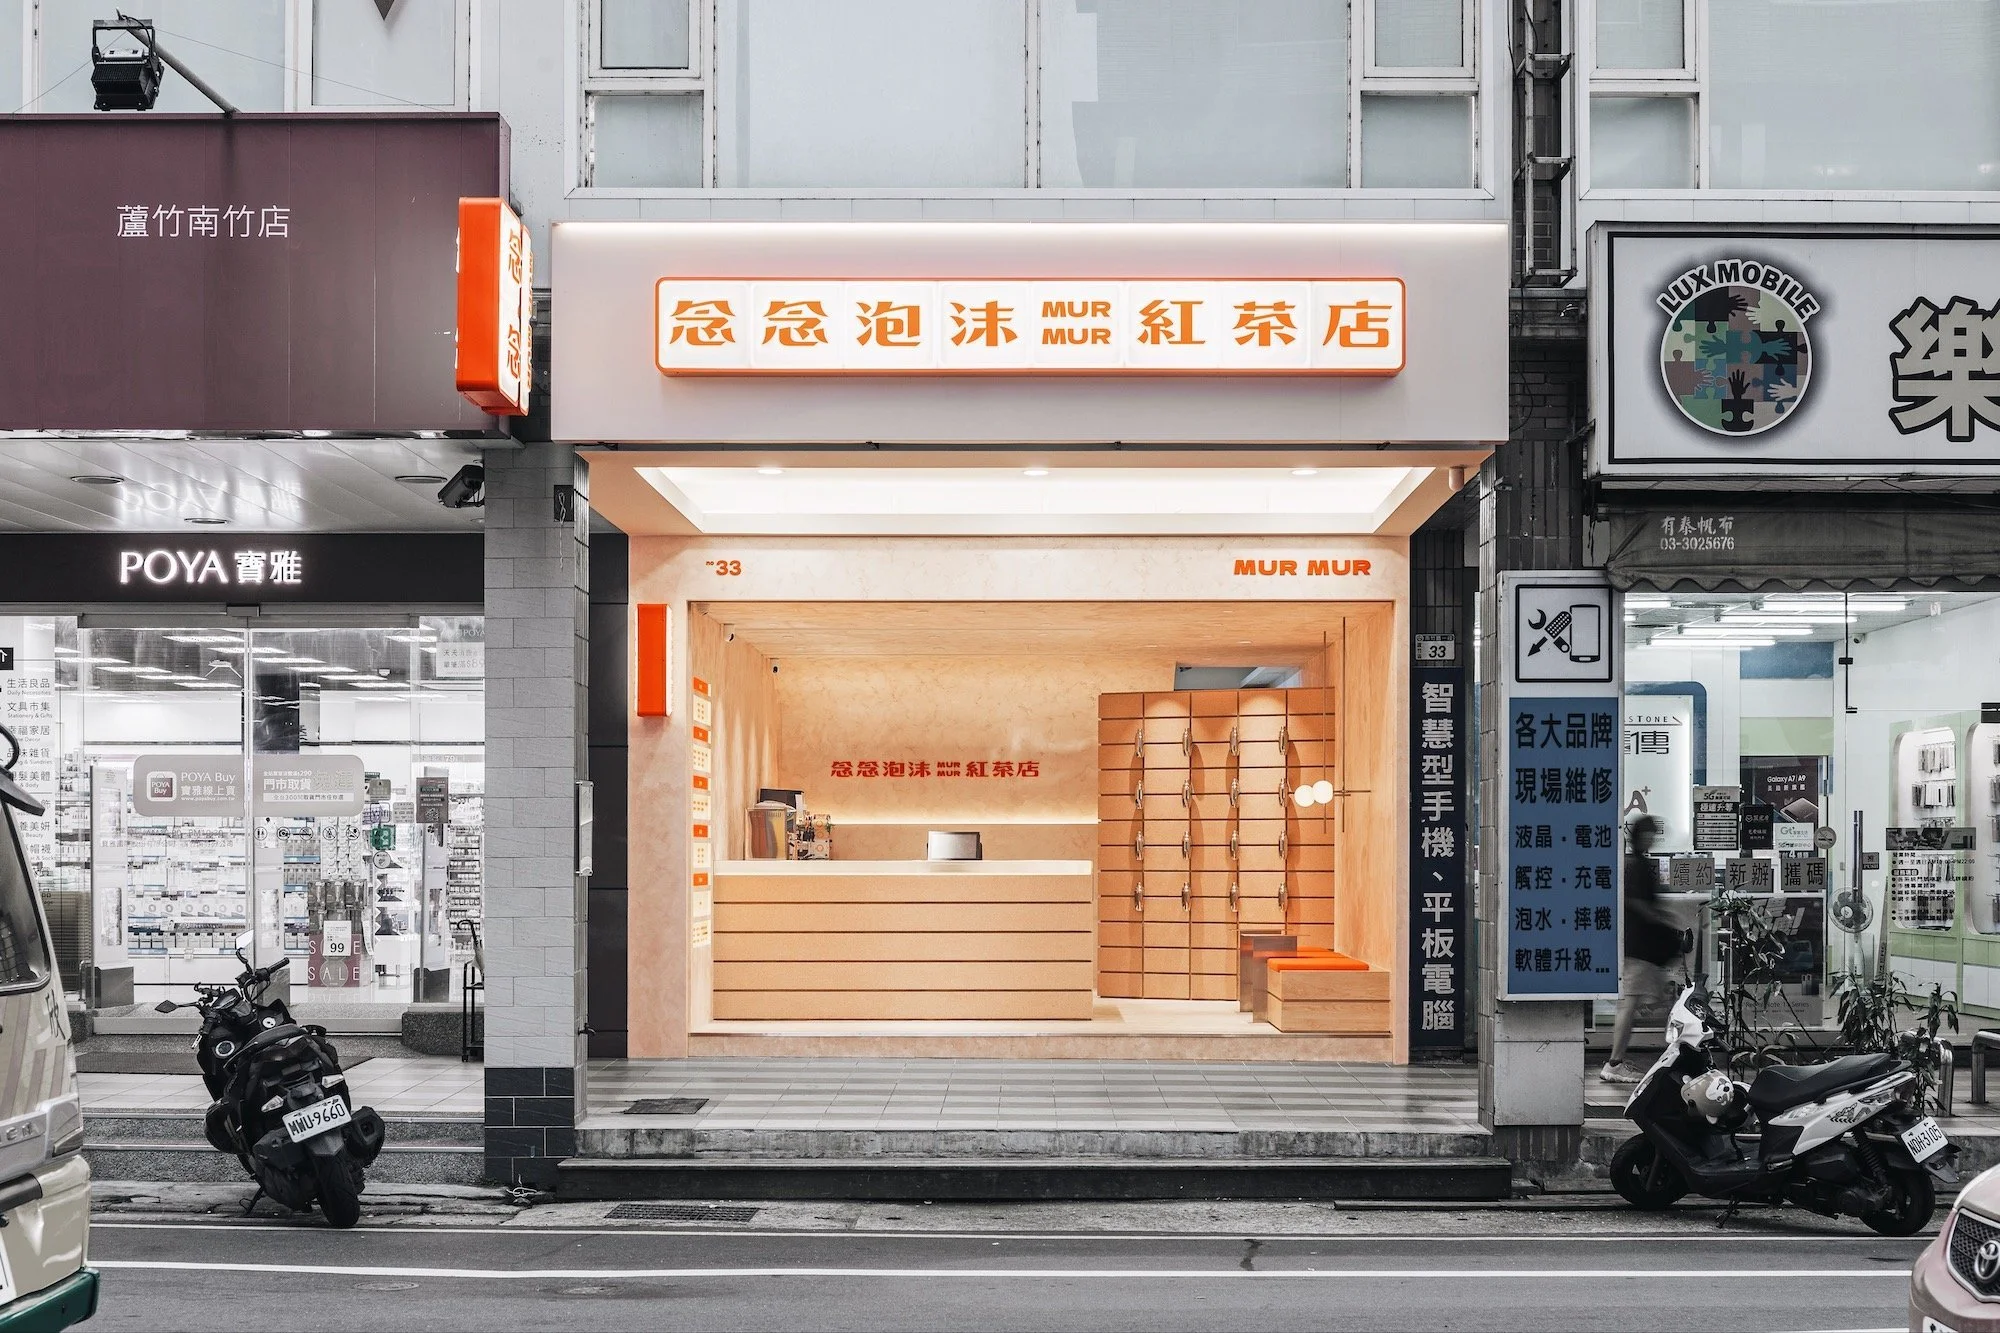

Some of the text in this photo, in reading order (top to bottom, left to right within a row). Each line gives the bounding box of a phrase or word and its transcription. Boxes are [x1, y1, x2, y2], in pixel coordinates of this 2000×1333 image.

[116, 204, 291, 239] 蘆竹南竹店
[1659, 262, 1817, 320] LUX MOBILE
[669, 299, 1393, 348] 念念泡沫 MUR MUR 紅茶店
[1889, 296, 2000, 442] 樂
[1660, 537, 1735, 550] 03-3025676
[119, 550, 302, 584] POYA 寶雅
[716, 560, 742, 576] 33
[1233, 559, 1372, 576] MUR MUR
[1428, 645, 1447, 658] 33
[7, 678, 50, 689] 生活良品
[7, 702, 51, 711] 文具市集
[1515, 712, 1613, 749] 各大品牌
[830, 760, 932, 778] 念念泡沫
[965, 760, 1040, 778] 紅茶店
[181, 772, 236, 784] POYA Buy
[264, 778, 311, 791] 門市取貨
[1515, 767, 1613, 804] 現場維修
[154, 787, 167, 795] Buy
[181, 785, 236, 797] 寶雅線上買
[1703, 792, 1715, 800] 5G
[20, 821, 50, 832] 養美妍
[1421, 681, 1455, 1031] 智慧型手機、平板電腦
[1674, 862, 1713, 886] 續約
[1729, 862, 1769, 886] 新辦
[1784, 862, 1824, 886] 攜碼
[308, 940, 361, 955] SE
[330, 942, 345, 953] 99
[308, 966, 360, 981] SALE
[287, 1102, 346, 1136] MWU-9660
[1907, 1124, 1942, 1156] NDH-3105
